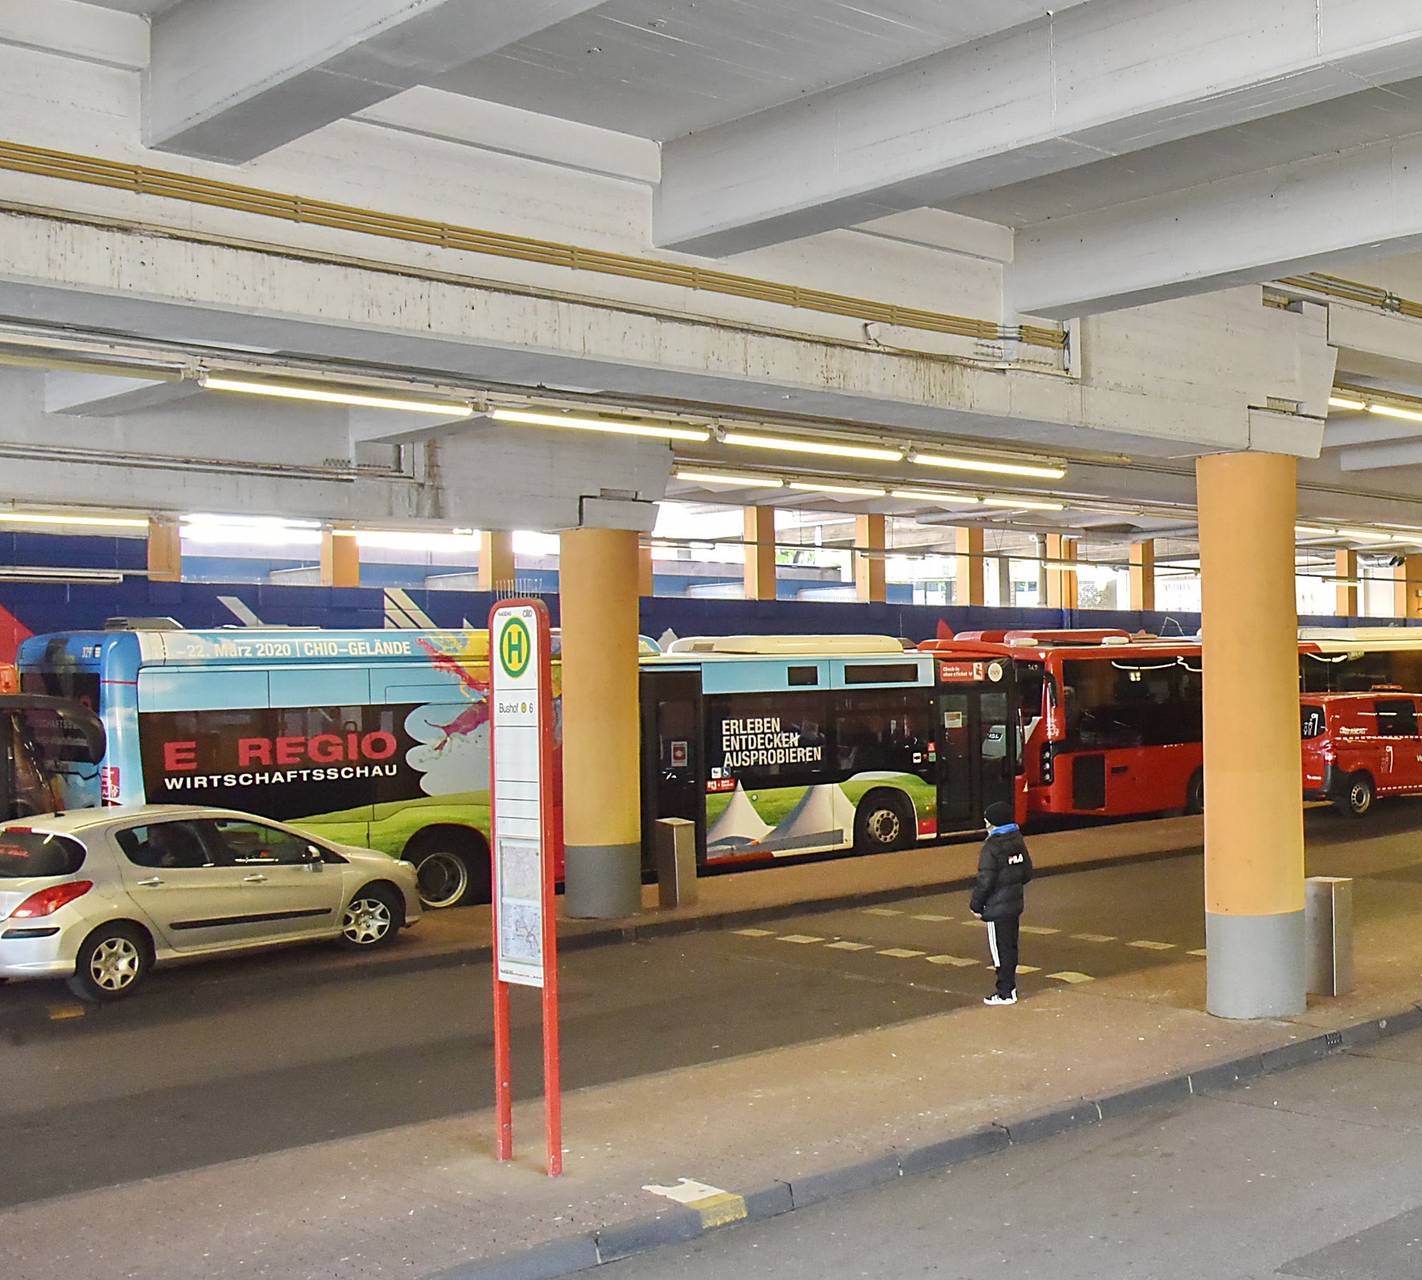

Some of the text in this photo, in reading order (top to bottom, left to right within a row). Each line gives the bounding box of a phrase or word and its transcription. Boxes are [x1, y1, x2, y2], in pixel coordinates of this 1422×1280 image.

[256, 642, 291, 656] 2020
[499, 702, 519, 713] Bushof
[721, 717, 780, 735] ERLEBEN
[722, 732, 799, 751] ENTDECKEN
[723, 746, 822, 768] AUSPROBIEREN
[164, 764, 397, 790] WIRTSCHAFTSSCHAU
